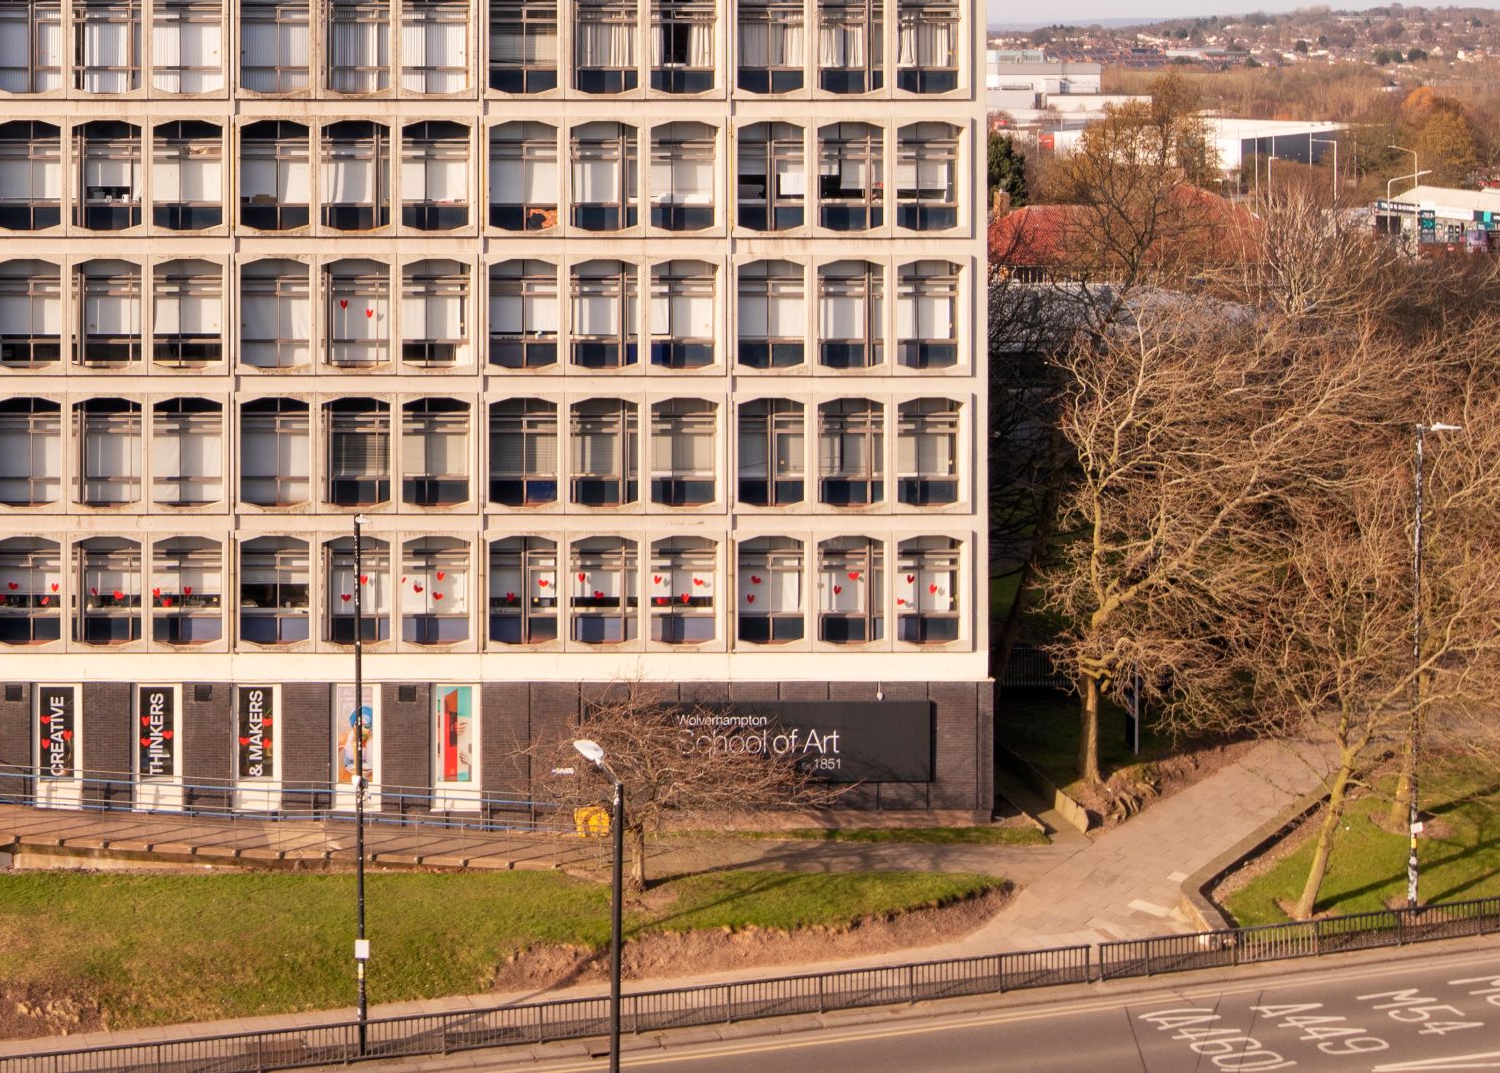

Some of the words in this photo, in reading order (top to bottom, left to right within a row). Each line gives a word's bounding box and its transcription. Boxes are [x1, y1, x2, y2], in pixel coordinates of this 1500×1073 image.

[50, 696, 65, 776] CREATIVE
[149, 693, 164, 775] THINKERS
[249, 690, 263, 760] MAKERS
[677, 714, 767, 727] Wolverhampton
[677, 729, 767, 754] School
[773, 728, 798, 754] of
[803, 729, 840, 754] Art
[249, 764, 263, 777] &
[814, 758, 841, 769] 1851
[1250, 1003, 1390, 1055] A449
[1356, 988, 1484, 1036] M54
